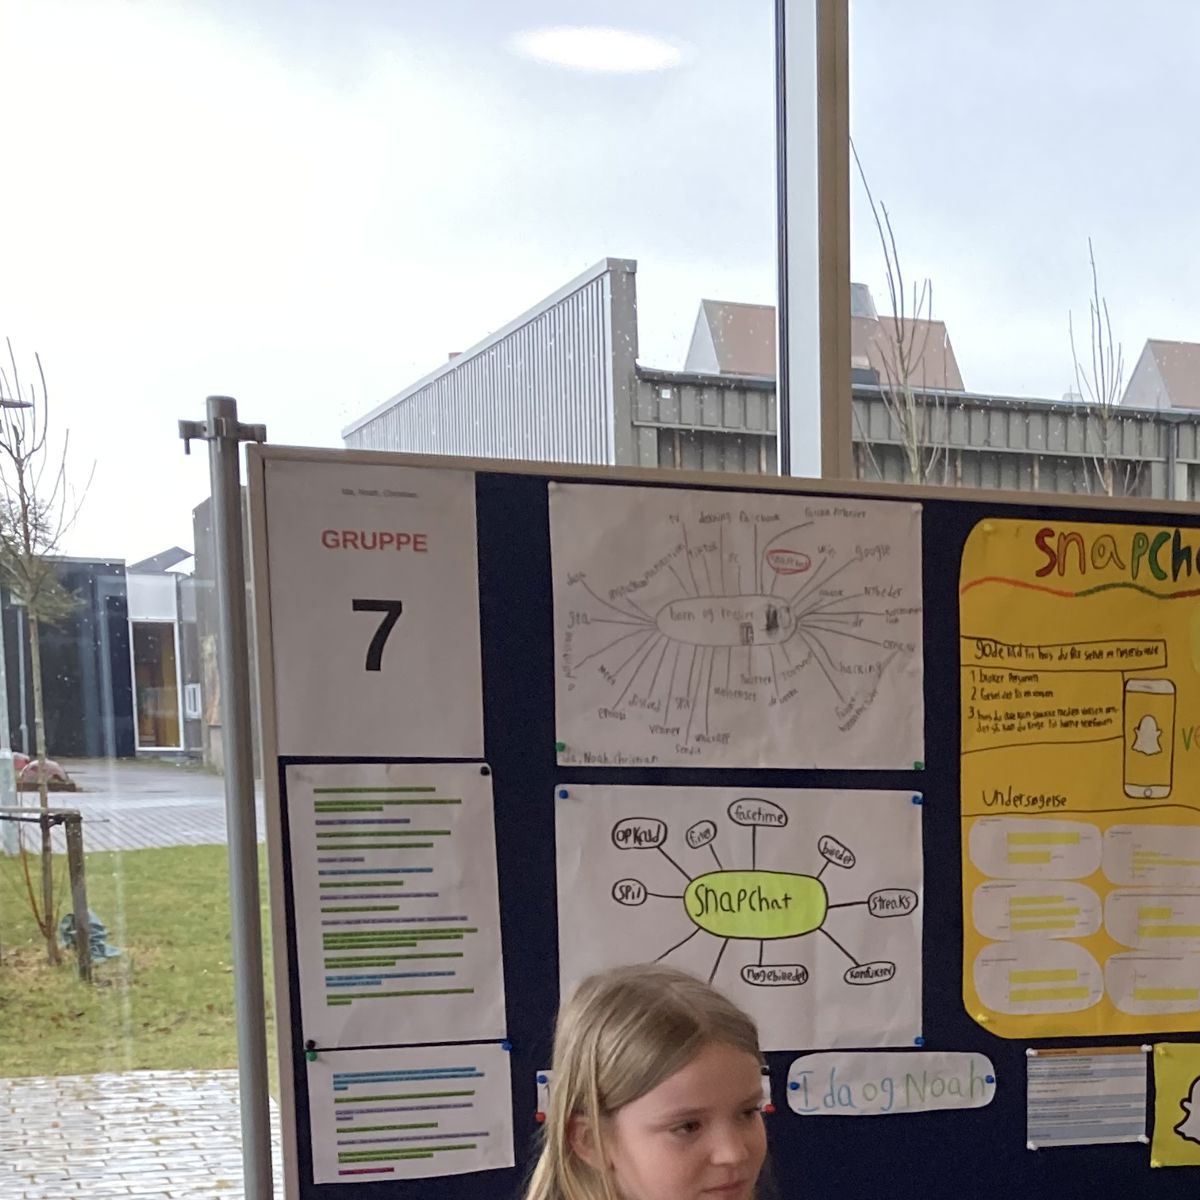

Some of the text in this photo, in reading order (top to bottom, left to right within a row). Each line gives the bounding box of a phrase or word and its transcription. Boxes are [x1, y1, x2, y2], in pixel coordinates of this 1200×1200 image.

[321, 529, 428, 552] GRUPPE
[352, 598, 403, 672] 7
[970, 686, 977, 701] 2
[968, 706, 975, 720] 3
[861, 1076, 894, 1112] og
[904, 1059, 987, 1105] Noah
